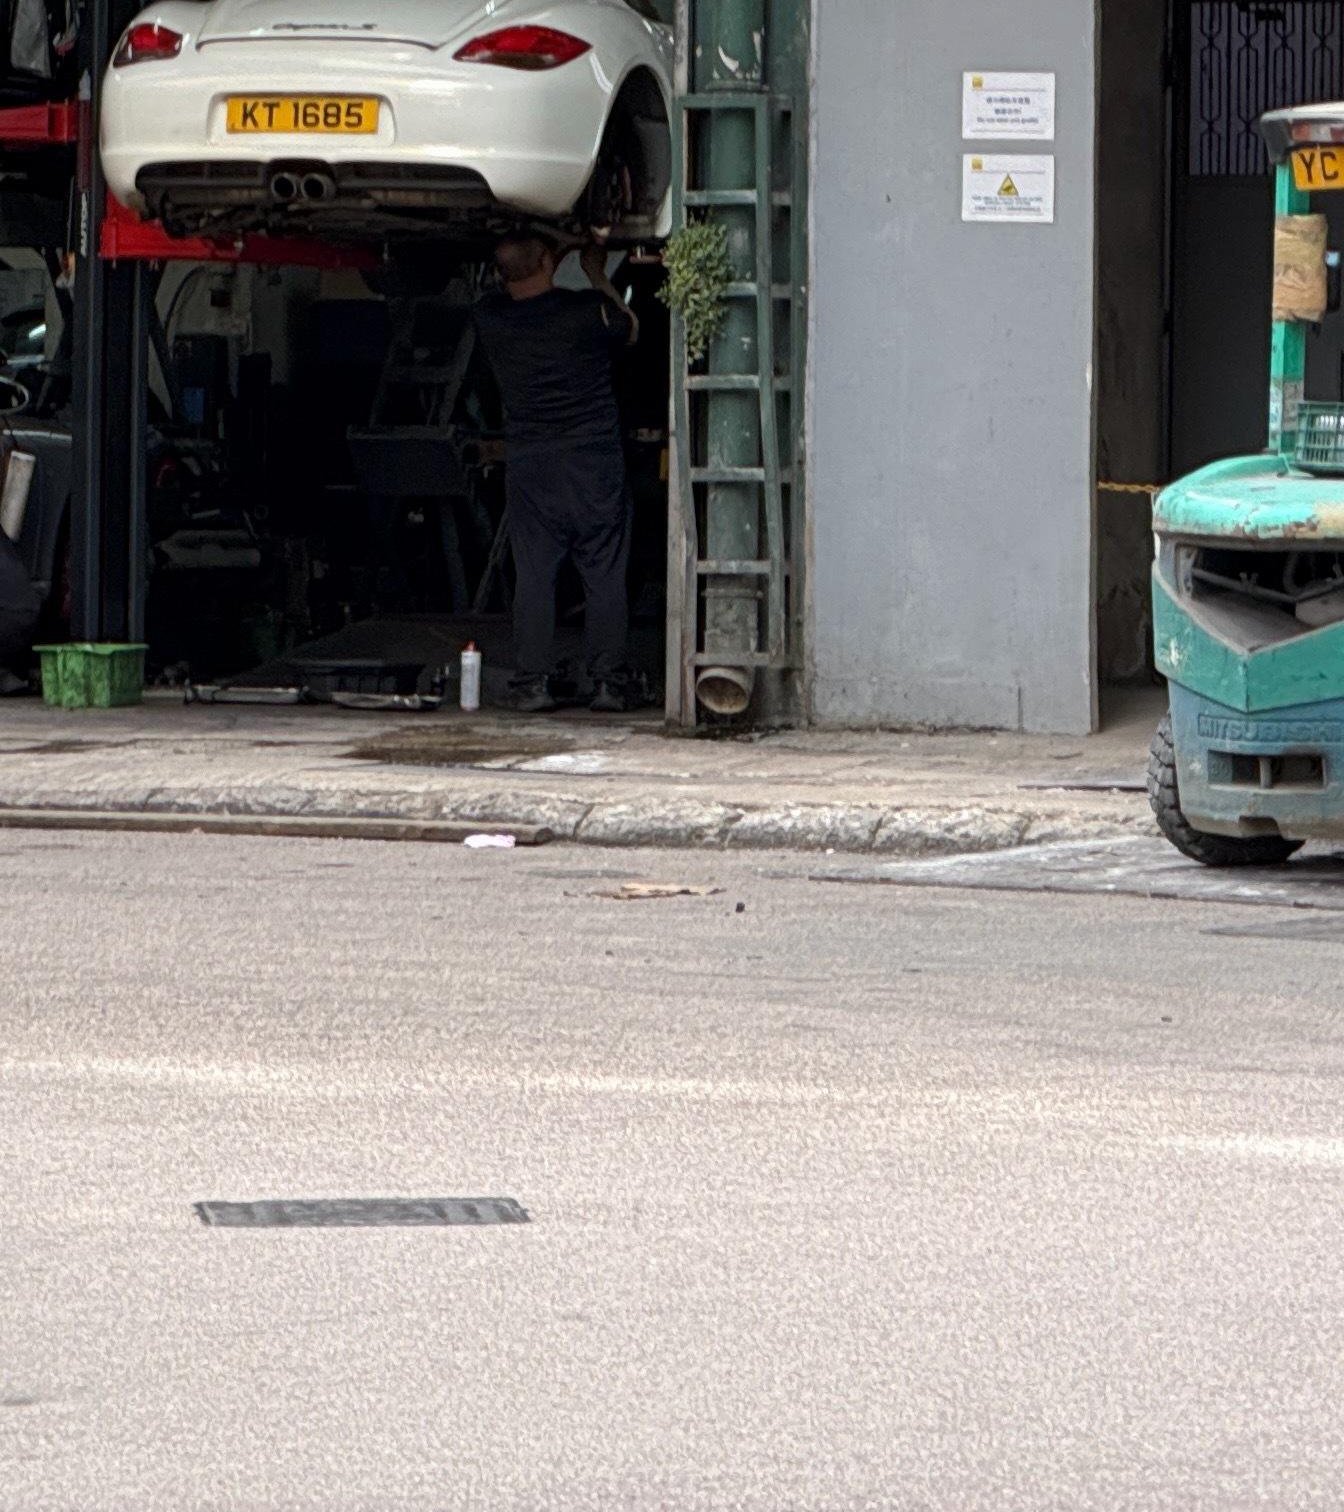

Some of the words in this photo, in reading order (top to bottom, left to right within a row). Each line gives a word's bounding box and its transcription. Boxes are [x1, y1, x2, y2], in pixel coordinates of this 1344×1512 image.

[241, 101, 280, 129] KT
[293, 101, 364, 129] 1685
[1297, 151, 1339, 184] YC
